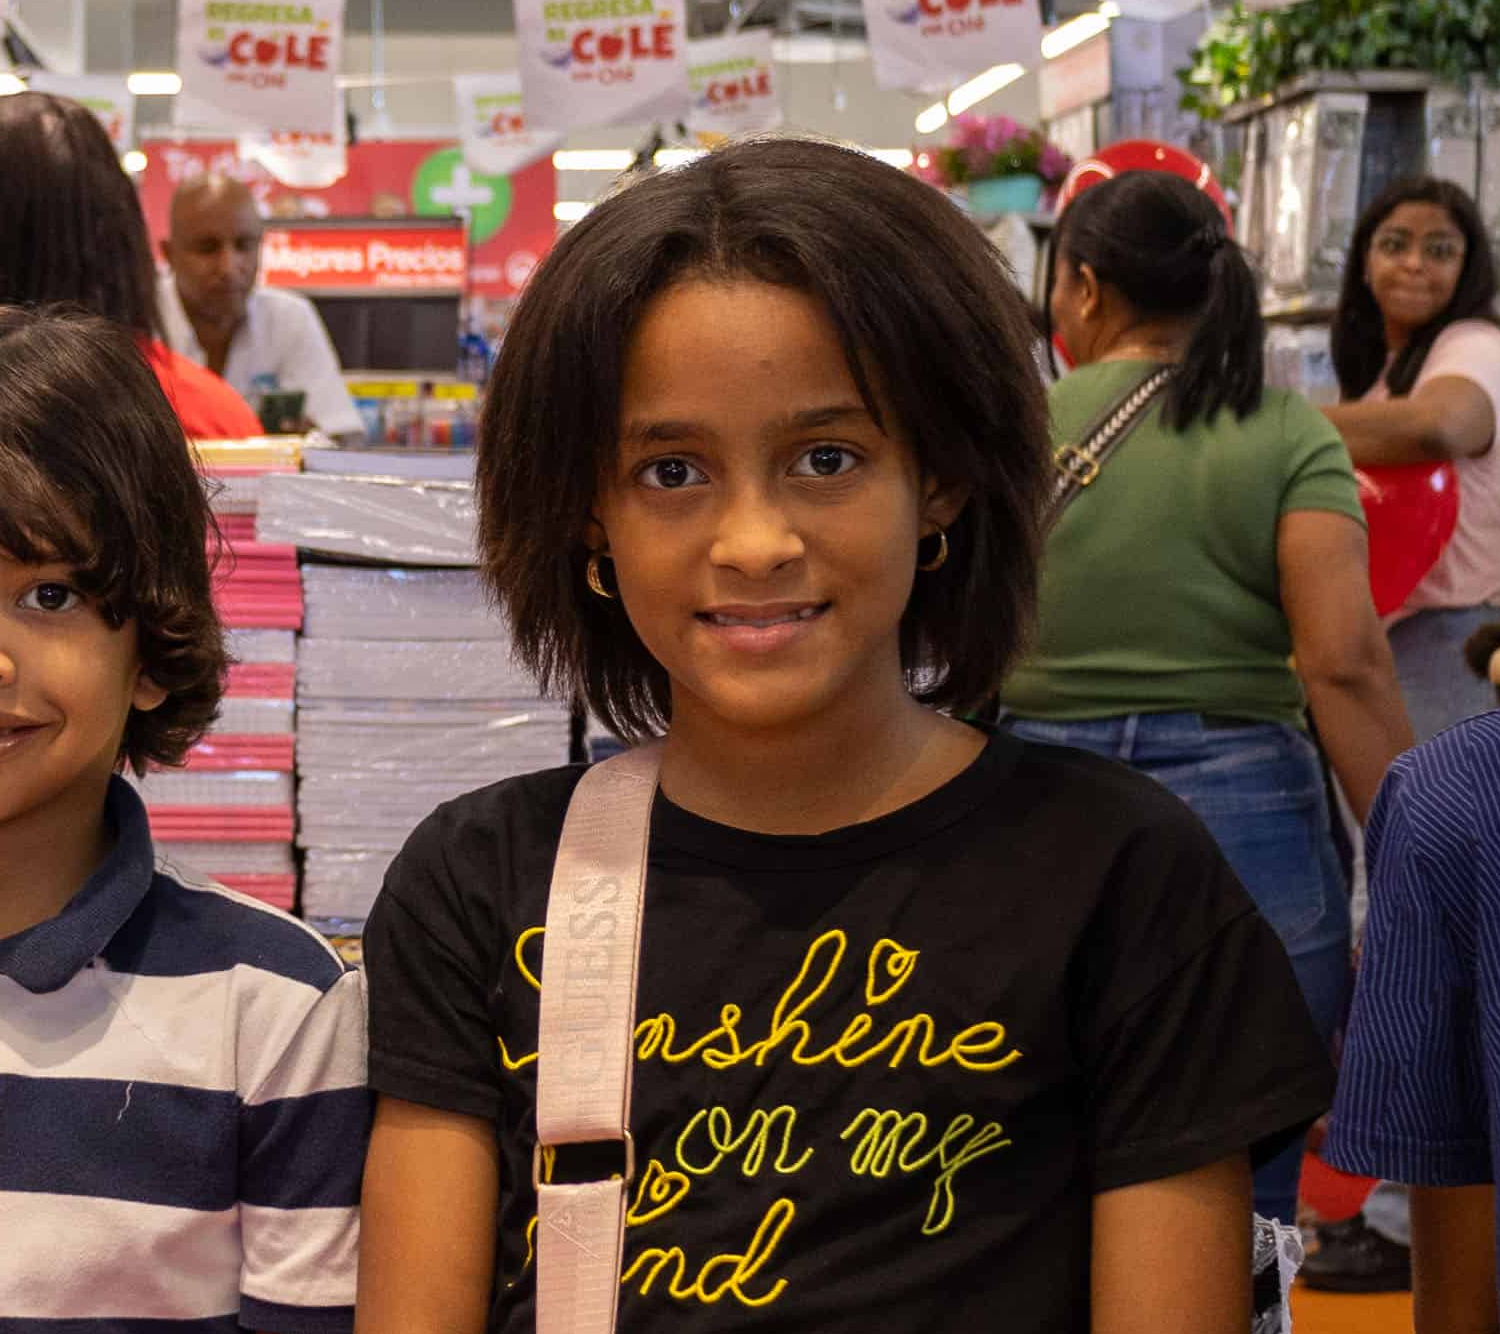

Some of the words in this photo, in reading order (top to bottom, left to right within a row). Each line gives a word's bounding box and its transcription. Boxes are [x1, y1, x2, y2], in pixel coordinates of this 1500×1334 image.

[263, 240, 364, 278] Mejores
[366, 238, 463, 272] Precios
[675, 1104, 814, 1177] on
[840, 1107, 1011, 1235] my
